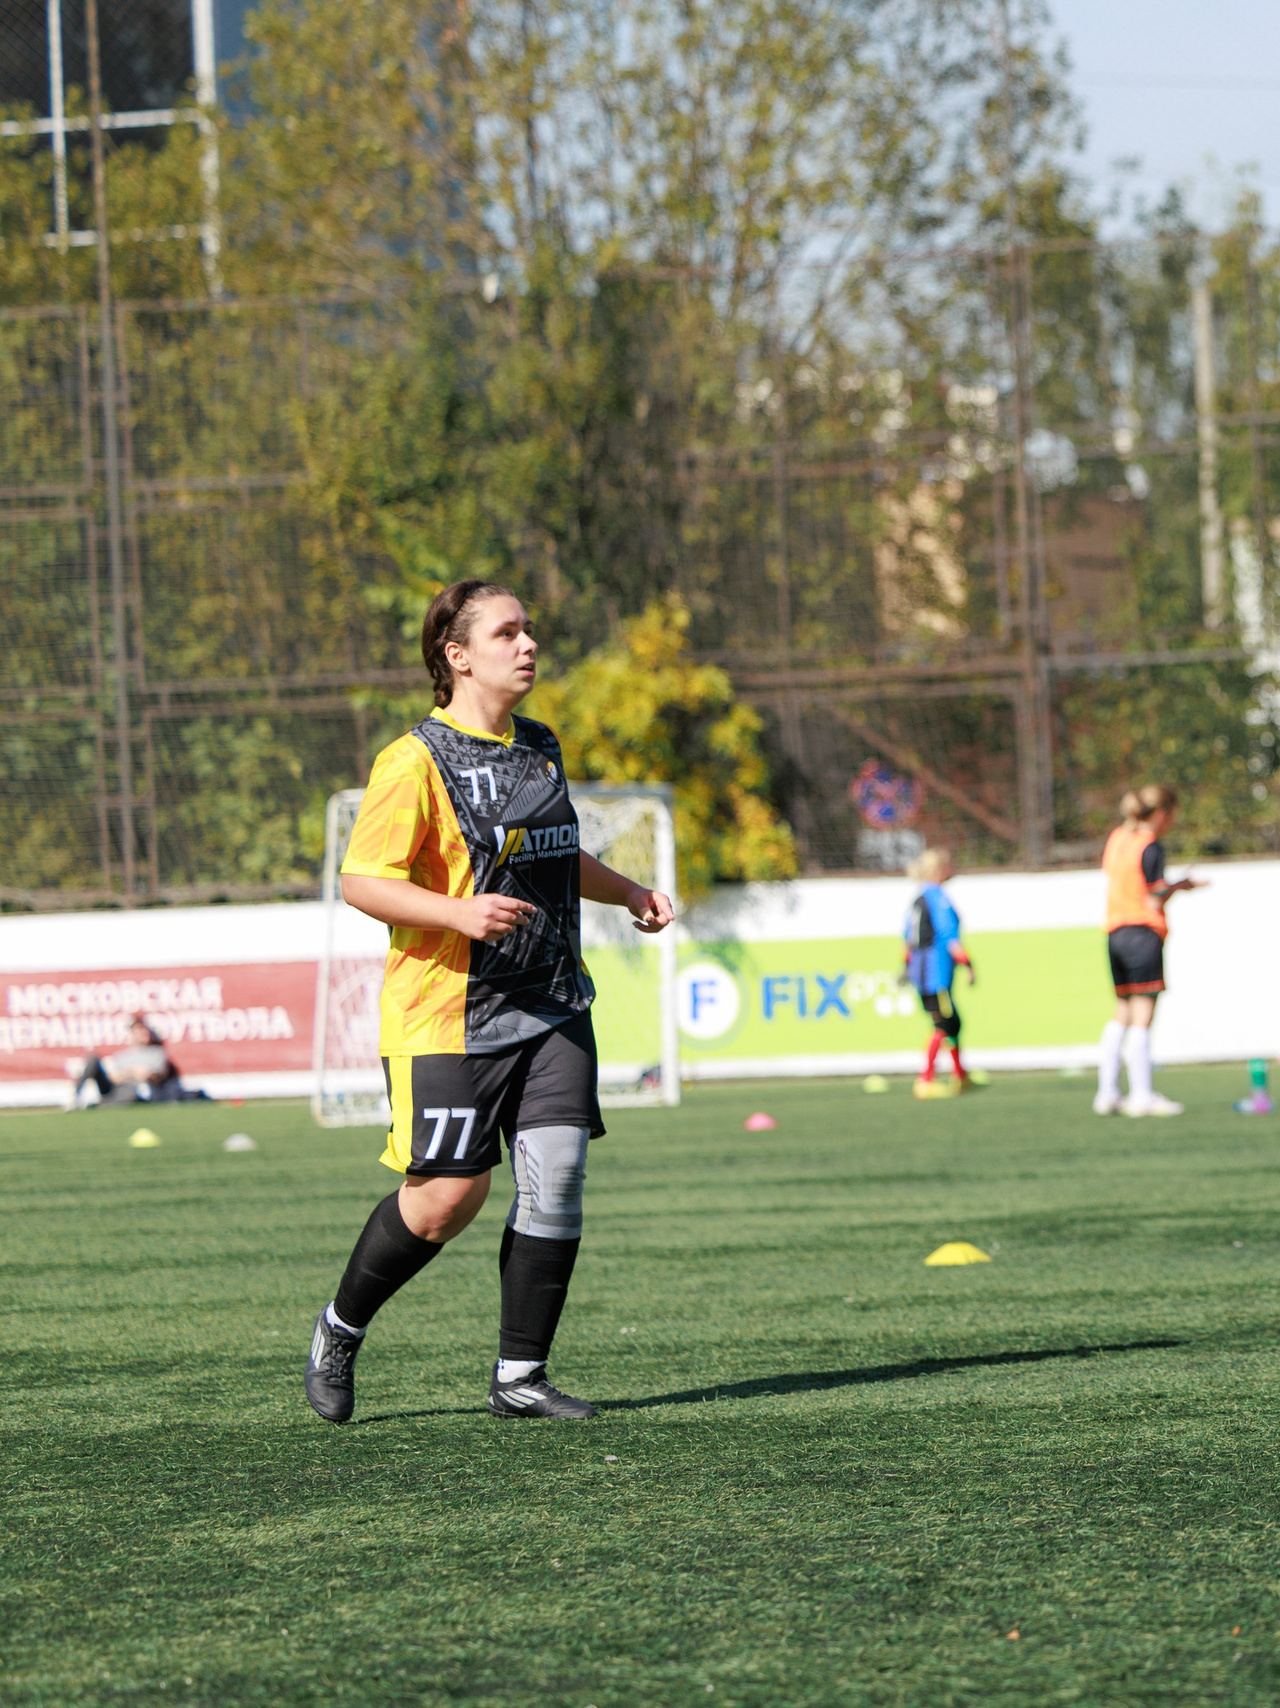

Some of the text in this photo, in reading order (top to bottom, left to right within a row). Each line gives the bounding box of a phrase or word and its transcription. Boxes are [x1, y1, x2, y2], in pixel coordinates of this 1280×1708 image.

[458, 766, 498, 805] 77
[508, 852, 536, 865] Facility
[7, 977, 223, 1017] МОСКОВСКАЯ
[690, 977, 718, 1021] F
[423, 1107, 477, 1160] 77
